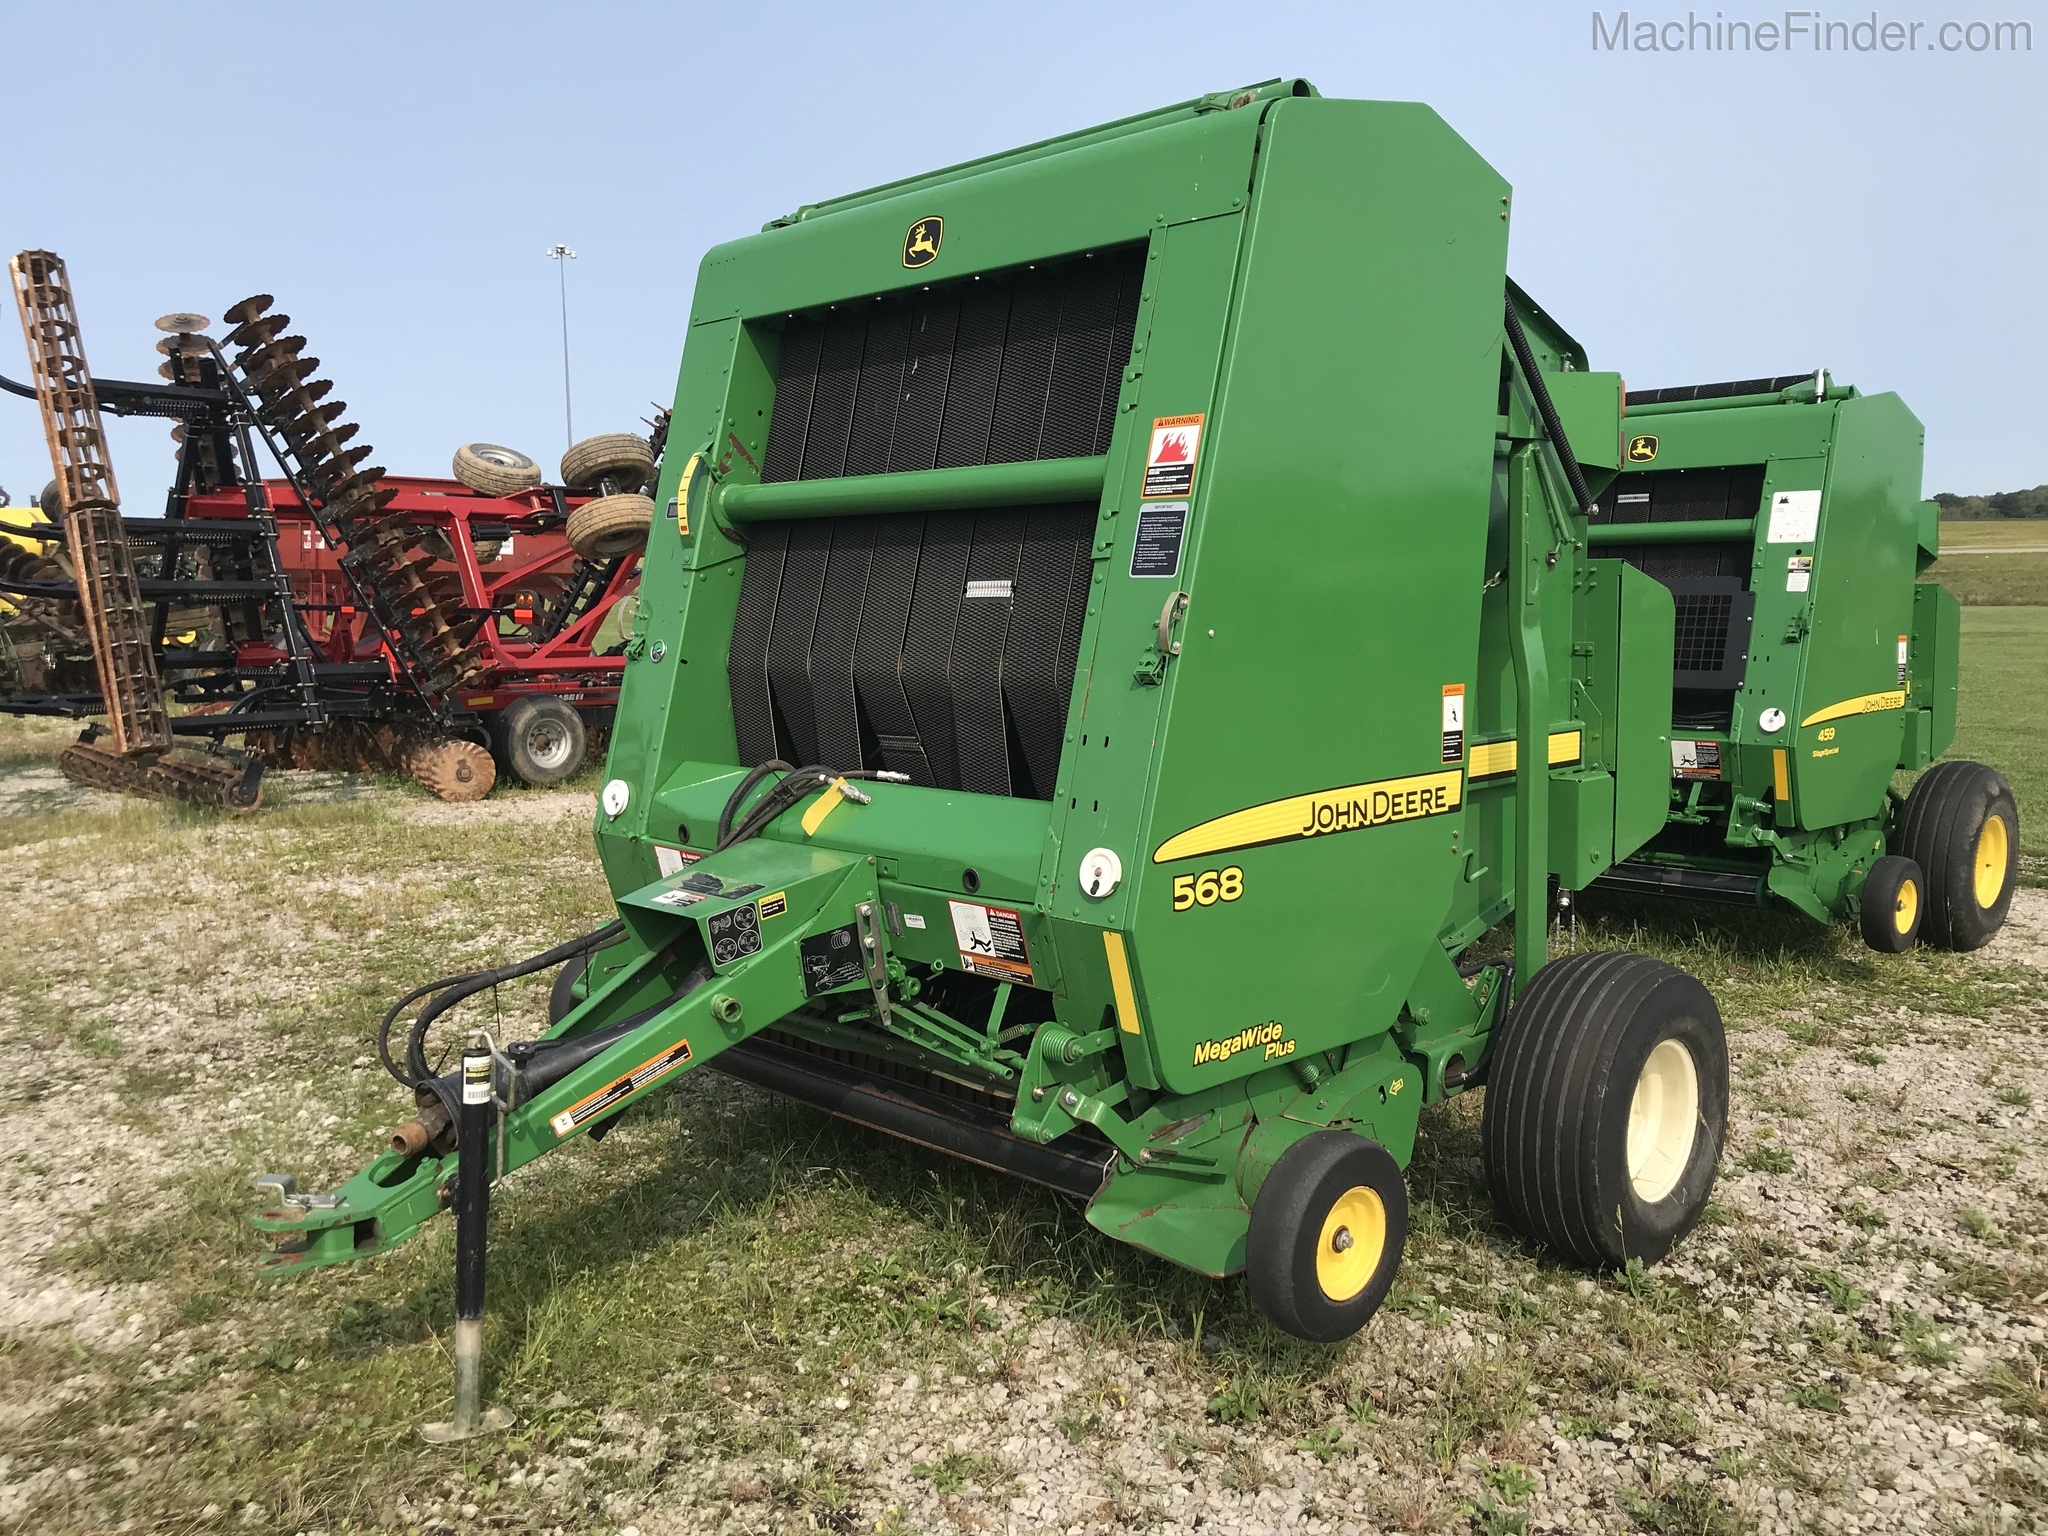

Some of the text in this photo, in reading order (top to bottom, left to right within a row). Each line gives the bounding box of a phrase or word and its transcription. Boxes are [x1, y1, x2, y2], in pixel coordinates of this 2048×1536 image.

[1164, 415, 1200, 426] WARNING
[1862, 696, 1902, 712] JOHN DEERE
[1817, 726, 1836, 742] 459
[1302, 786, 1447, 833] JOHN DEERE
[1172, 864, 1245, 913] 568
[995, 910, 1018, 920] DANGER
[1193, 1020, 1283, 1067] MegaWide
[1263, 1039, 1297, 1062] Plus
